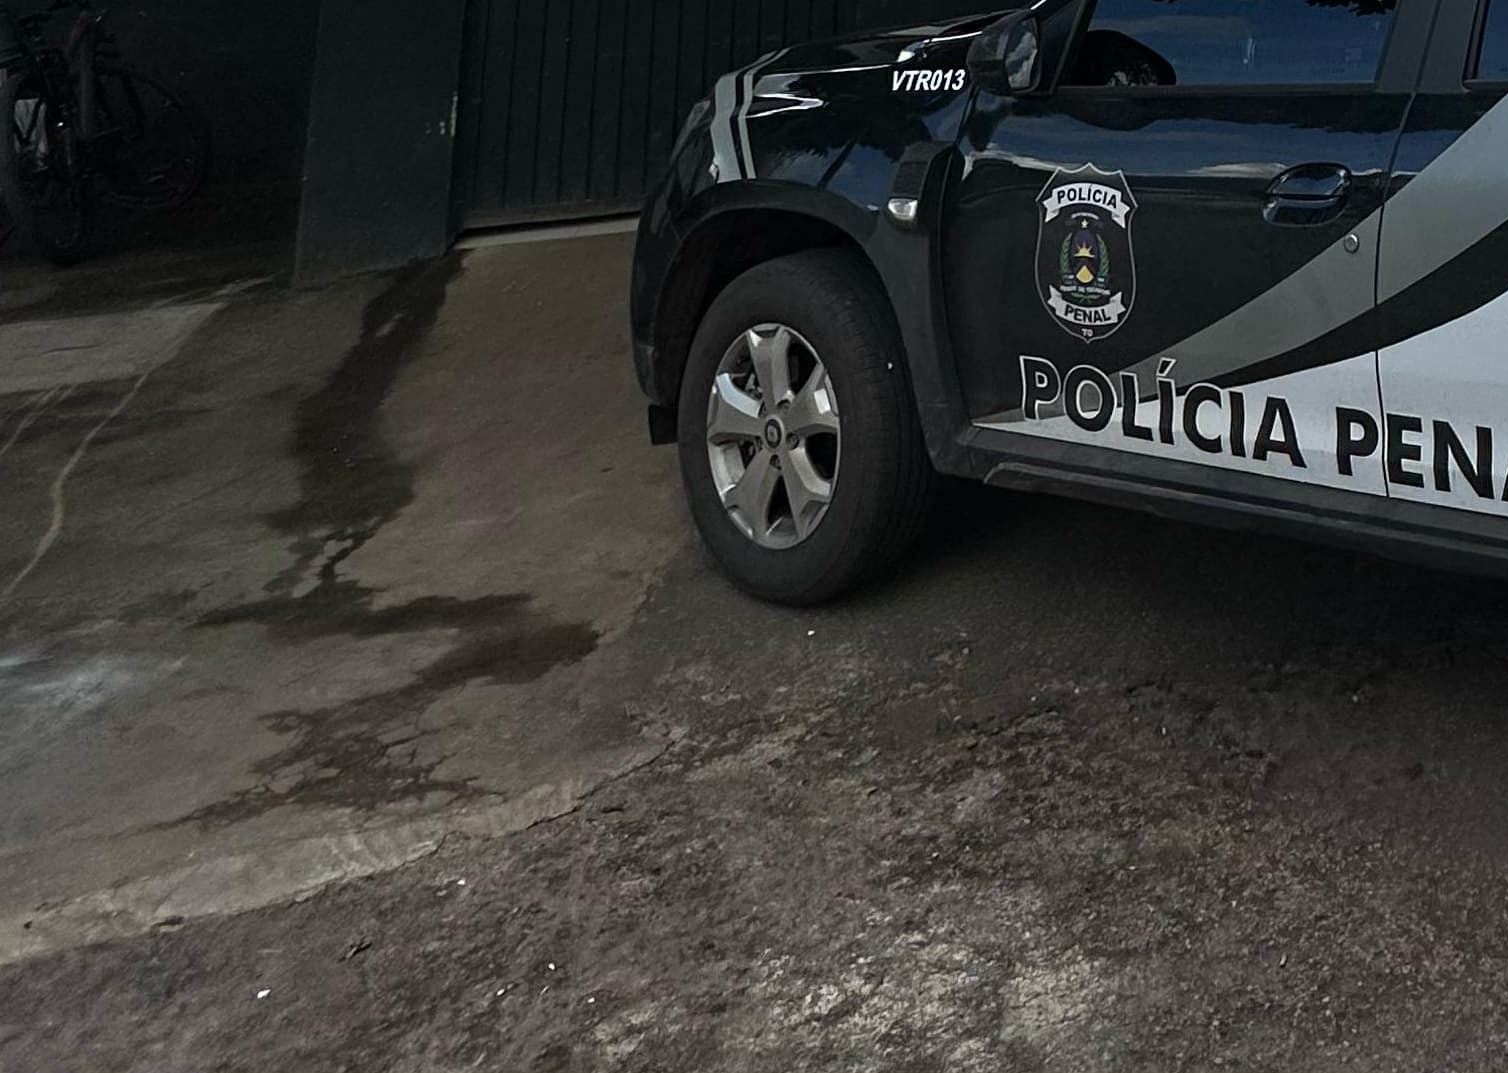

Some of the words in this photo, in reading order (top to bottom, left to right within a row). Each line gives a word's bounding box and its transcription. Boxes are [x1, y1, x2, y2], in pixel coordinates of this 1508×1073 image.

[892, 69, 966, 91] VTR013
[1057, 186, 1117, 209] POLÍCIA
[1064, 304, 1112, 323] PENAL
[1019, 355, 1307, 469] POLÍCIA
